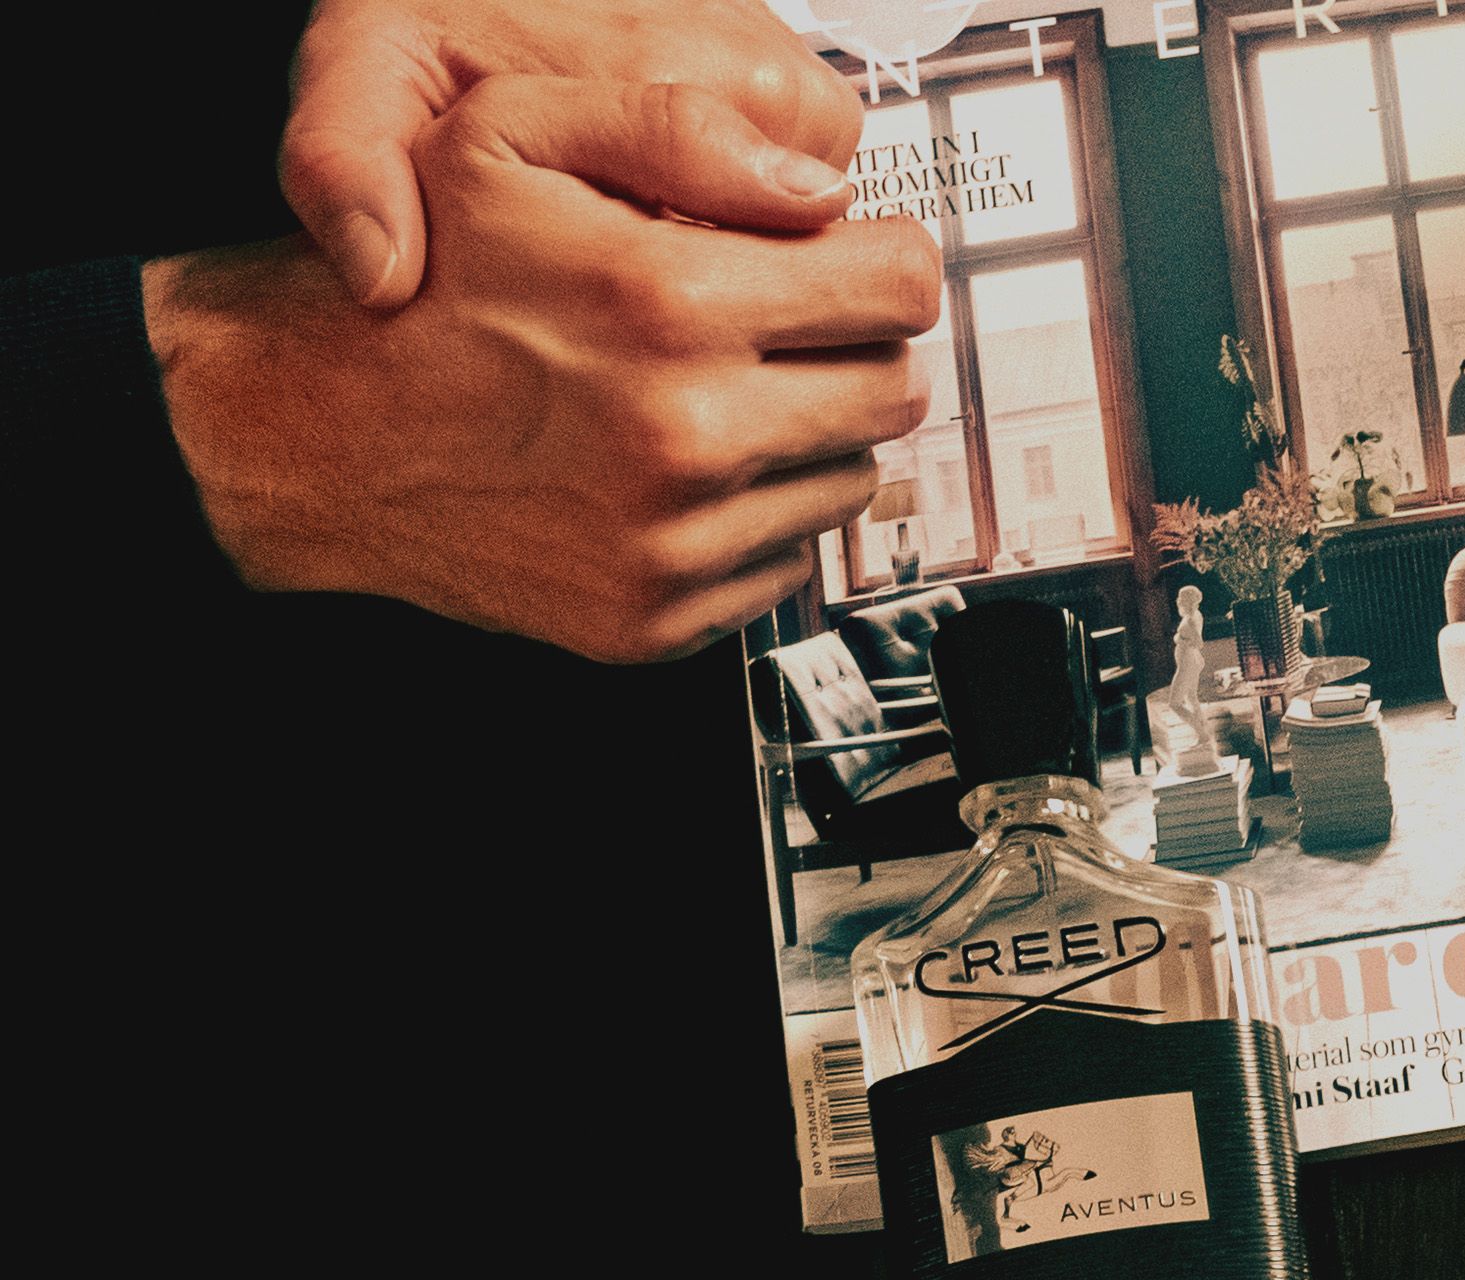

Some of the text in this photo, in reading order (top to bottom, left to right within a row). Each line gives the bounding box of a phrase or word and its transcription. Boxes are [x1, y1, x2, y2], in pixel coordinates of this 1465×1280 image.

[855, 131, 980, 175] ITTA IN I
[966, 179, 1035, 213] HEM
[914, 916, 1167, 1005] CREED
[1287, 1035, 1352, 1073] terial
[1359, 1034, 1417, 1062] som
[1332, 1064, 1415, 1104] Staaf
[804, 1079, 819, 1159] RETURVECKA
[1059, 1190, 1197, 1223] AVENTUS
